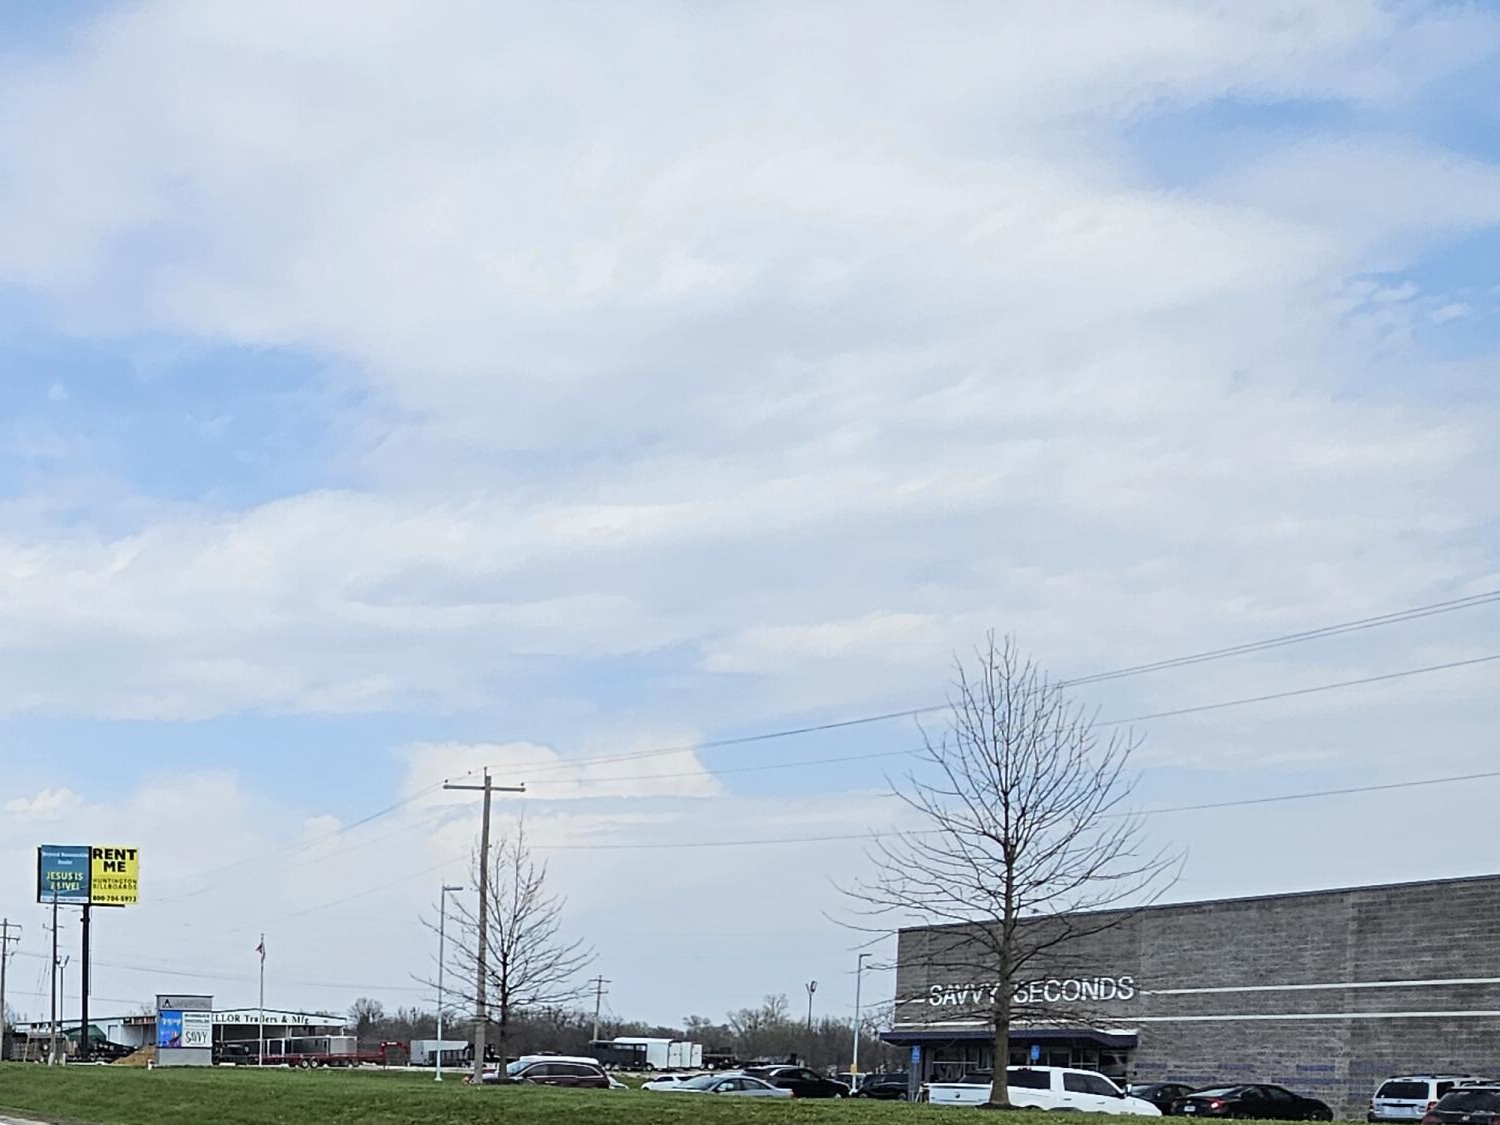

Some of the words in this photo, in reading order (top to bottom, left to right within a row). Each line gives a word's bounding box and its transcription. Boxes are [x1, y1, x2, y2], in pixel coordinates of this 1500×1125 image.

[92, 847, 137, 860] RENT
[103, 861, 127, 872] ME
[46, 871, 73, 881] JESUS
[74, 871, 84, 881] IS
[929, 982, 1001, 1007] SAVVY
[1013, 976, 1135, 1004] SECONDS
[244, 1014, 278, 1023] Tralers
[281, 1014, 288, 1023] &
